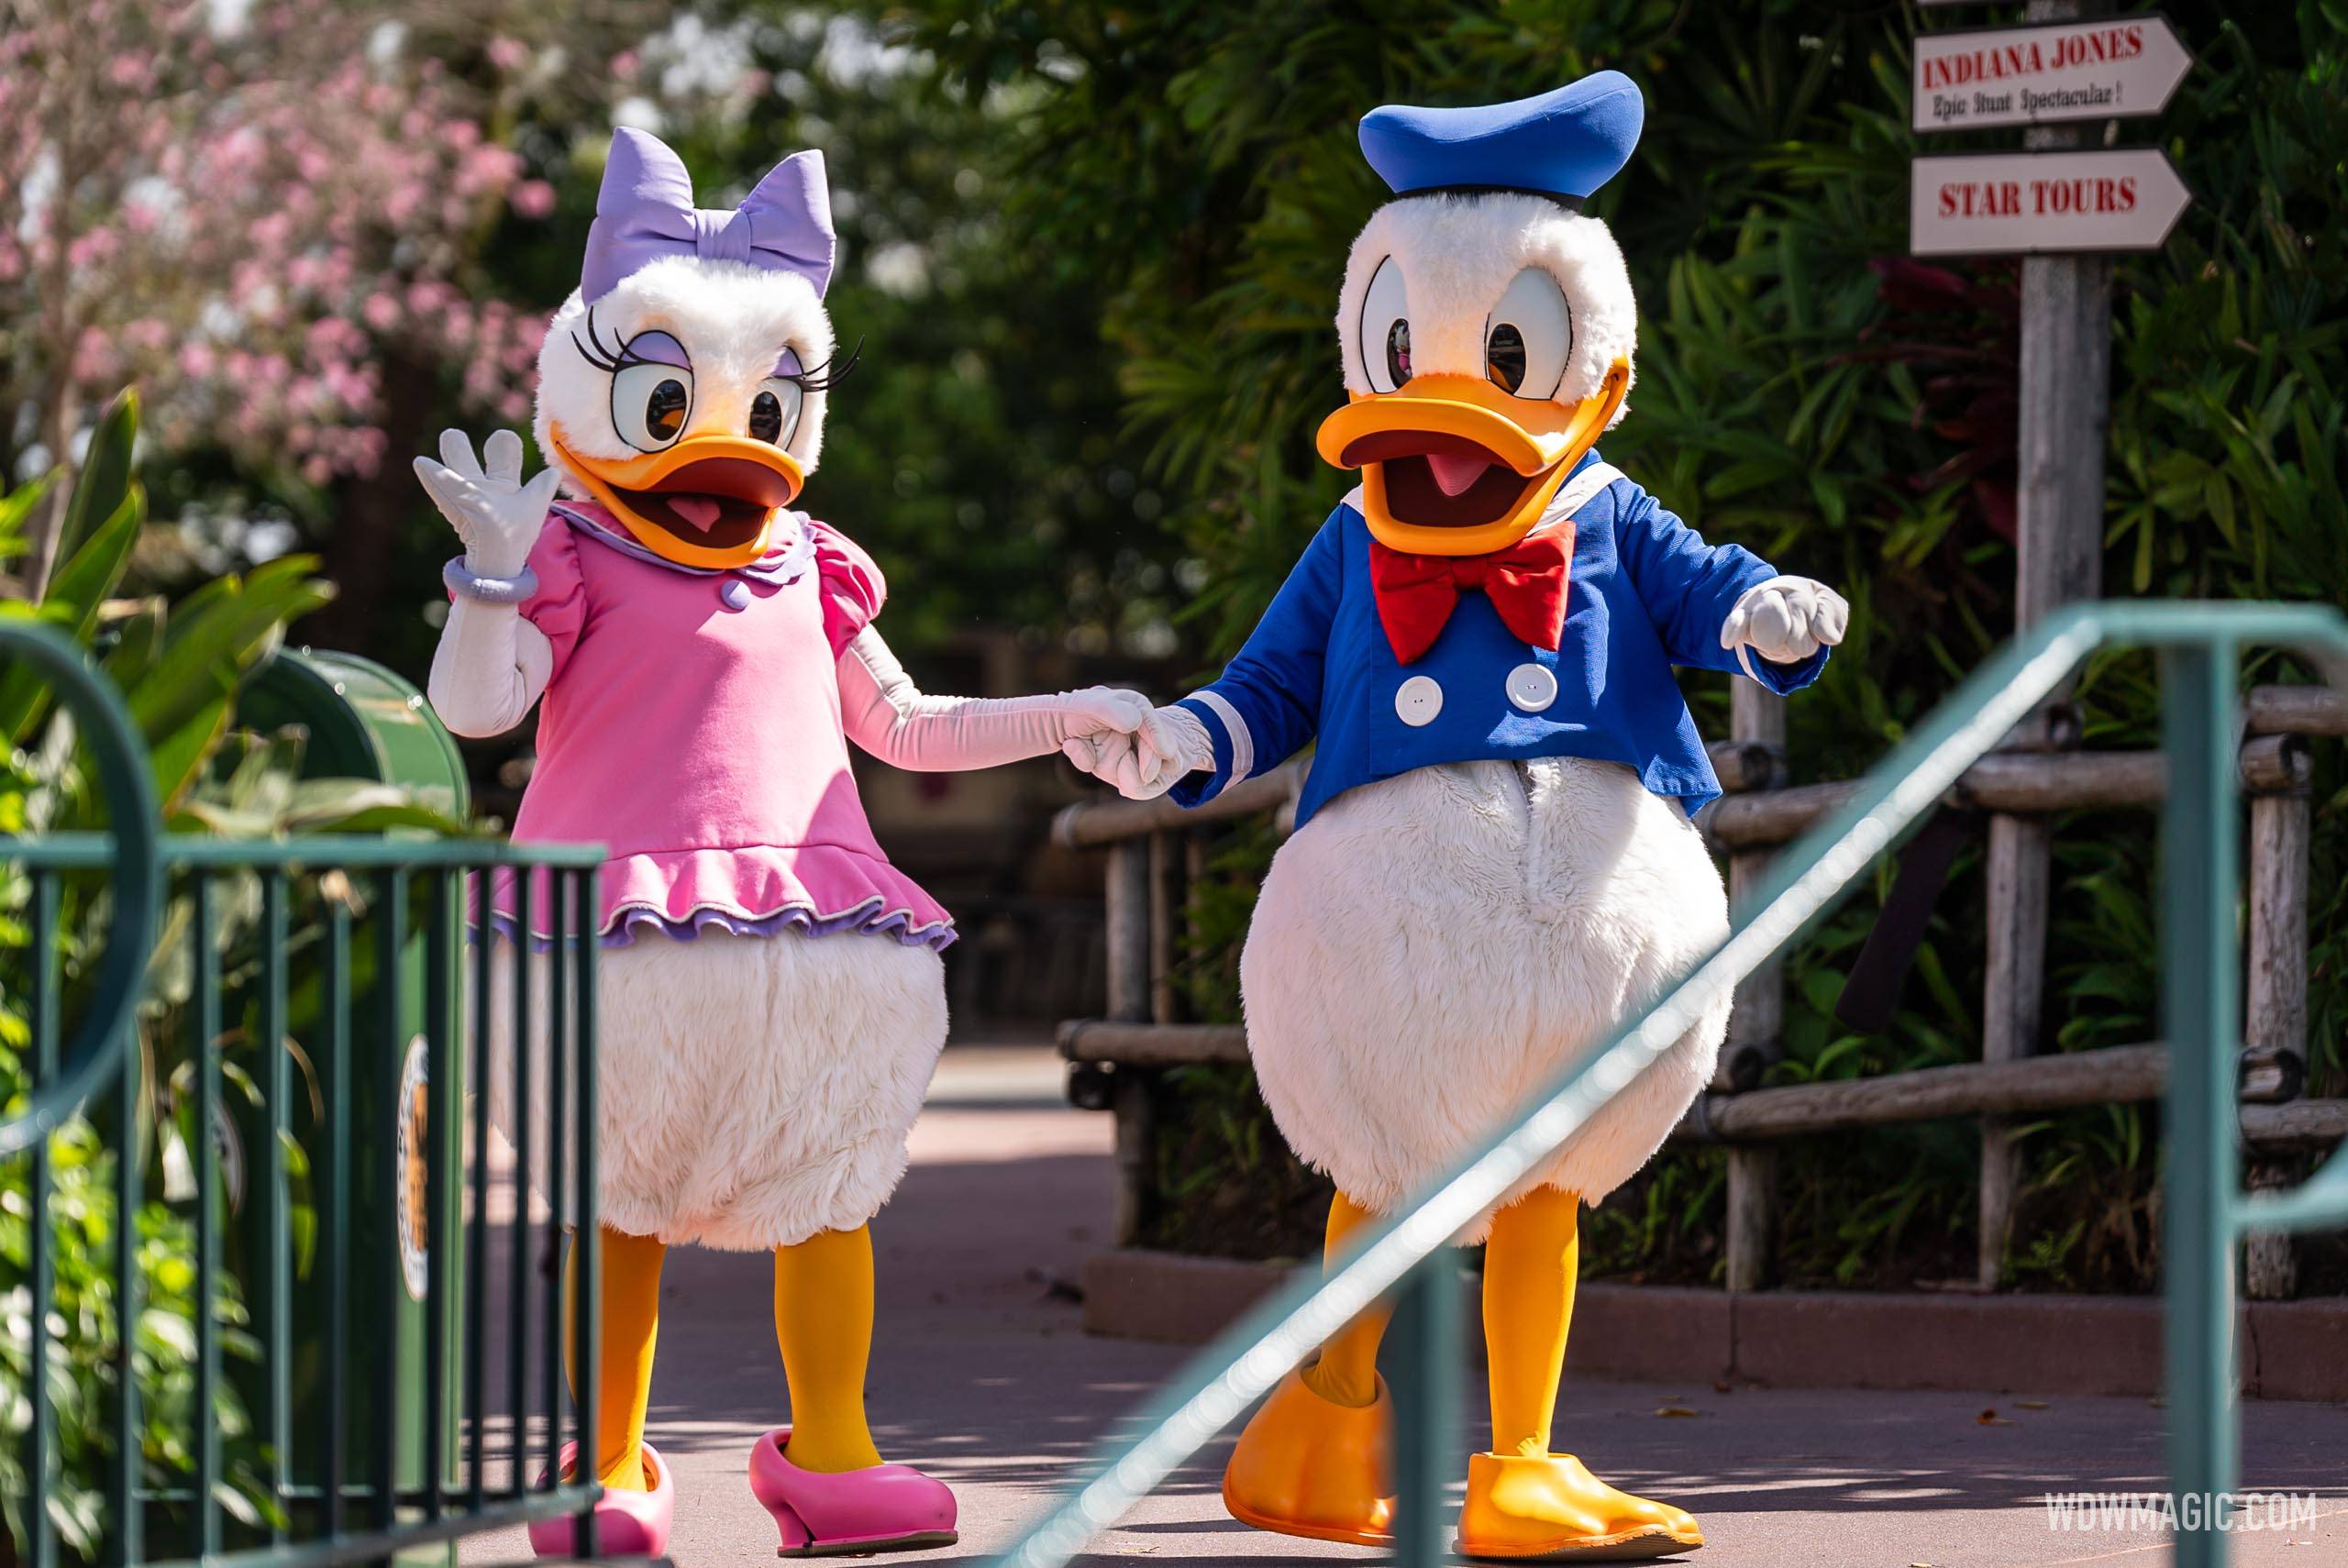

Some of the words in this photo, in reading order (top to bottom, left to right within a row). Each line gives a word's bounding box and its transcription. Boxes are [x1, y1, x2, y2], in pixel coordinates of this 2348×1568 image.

[1922, 42, 2043, 89] INDIANA
[2051, 26, 2143, 68] JONES
[1933, 94, 1966, 122] Epic
[1974, 89, 2010, 115] Stunt
[1938, 182, 2020, 218] STAR
[2030, 177, 2137, 215] TOURS
